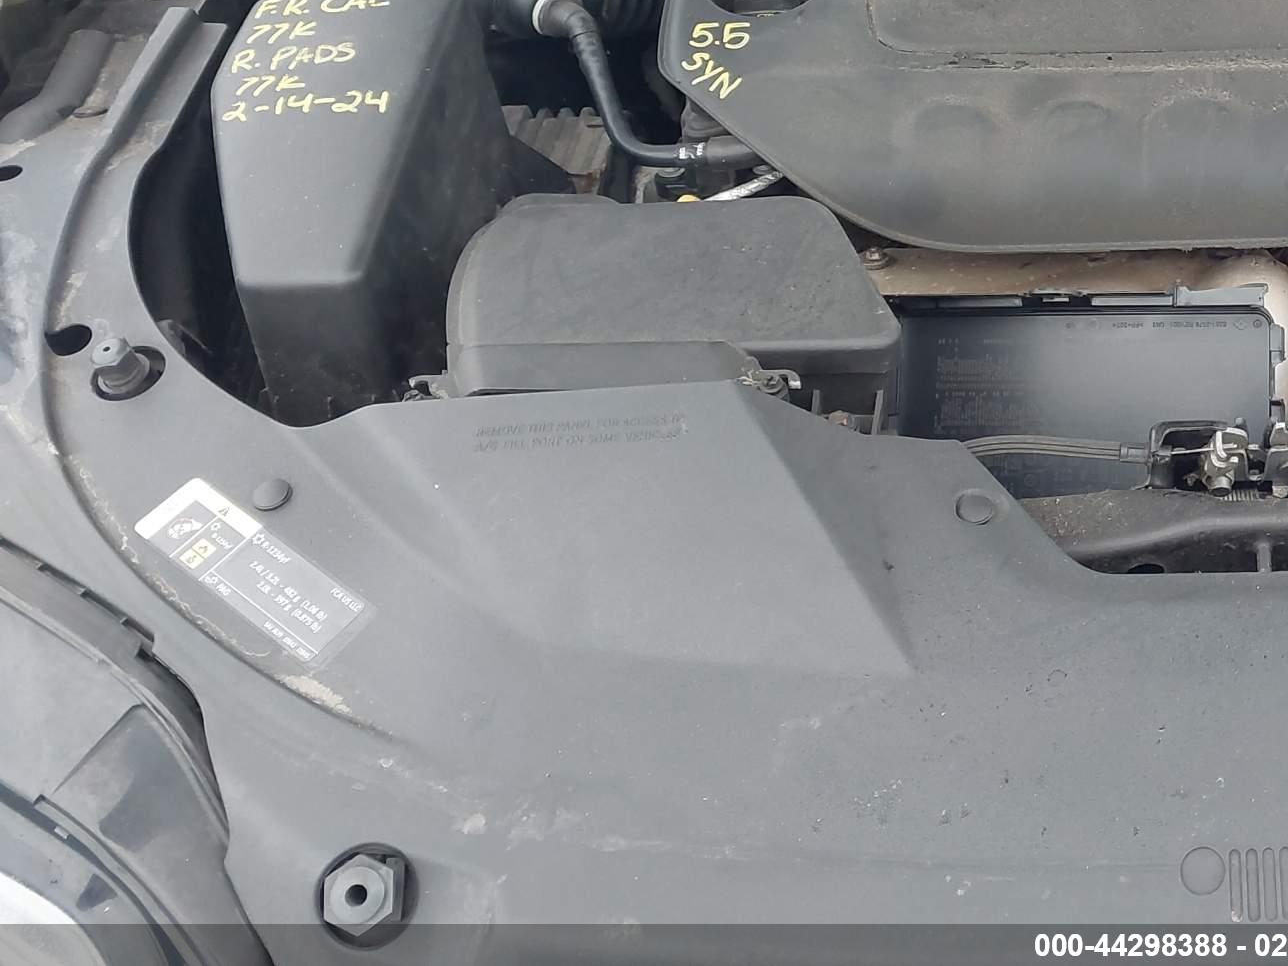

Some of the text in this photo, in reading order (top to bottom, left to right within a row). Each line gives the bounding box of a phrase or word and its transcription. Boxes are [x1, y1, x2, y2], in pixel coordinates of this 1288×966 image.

[246, 21, 317, 44] 77K
[688, 21, 752, 50] 5.5
[270, 41, 357, 71] PADS
[235, 73, 306, 97] 77K
[222, 90, 390, 123] 2-14-24
